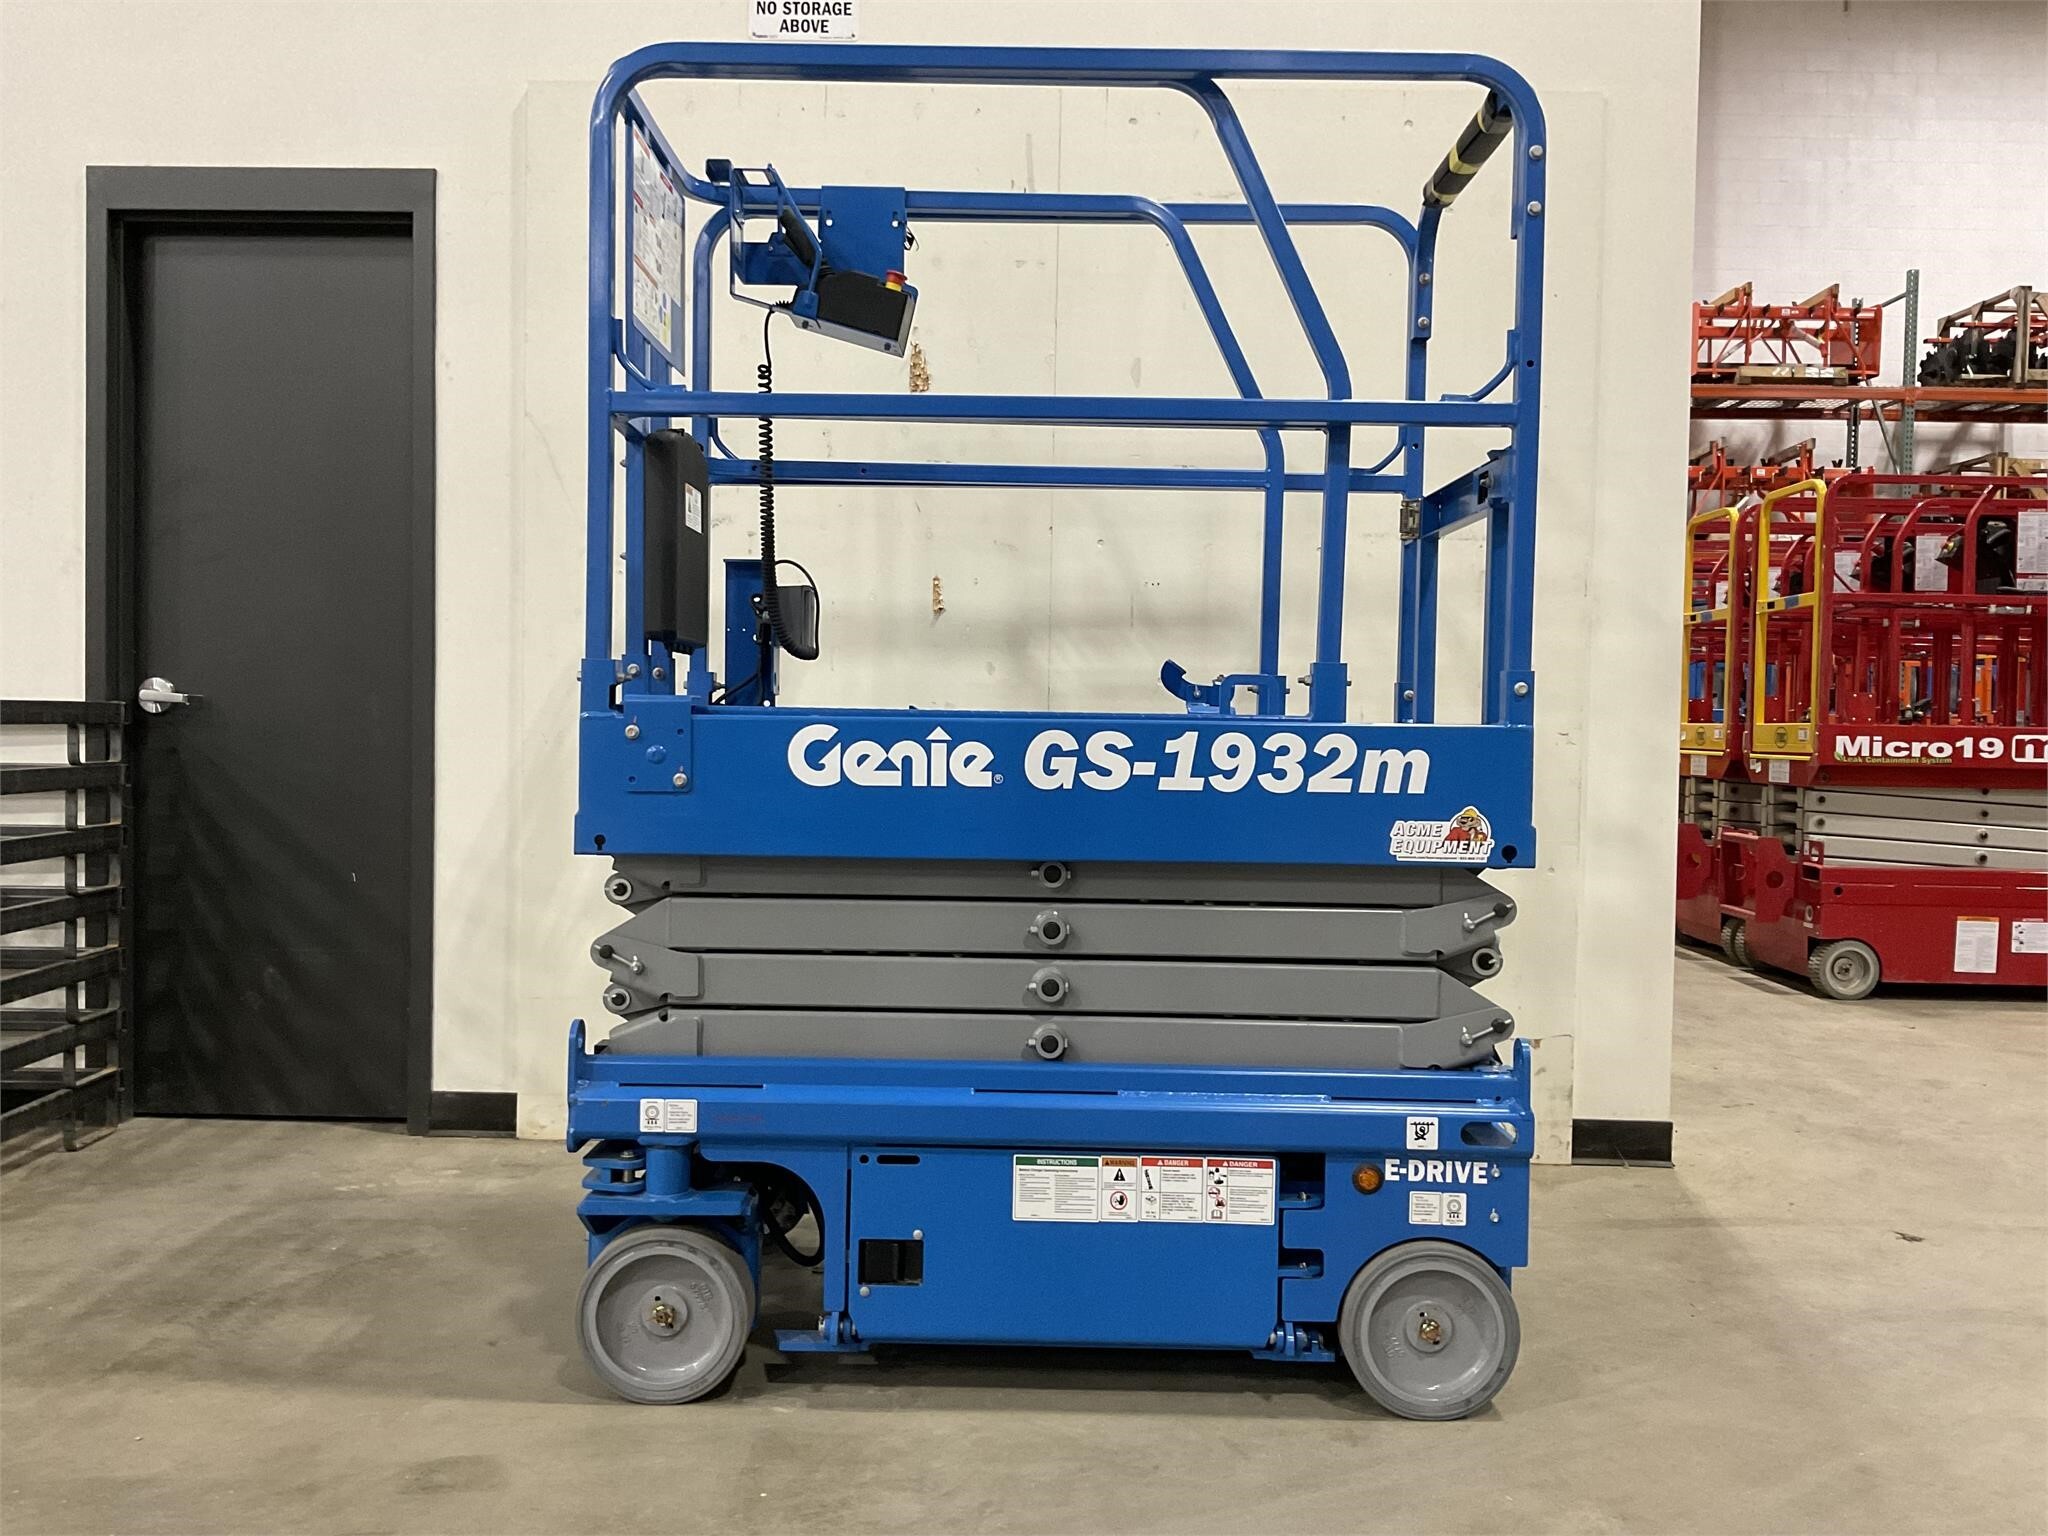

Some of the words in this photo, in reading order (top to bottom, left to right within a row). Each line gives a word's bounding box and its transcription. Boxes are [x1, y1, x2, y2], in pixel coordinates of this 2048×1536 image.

[757, 1, 777, 15] NO
[783, 1, 852, 16] STORAGE
[780, 19, 829, 33] ABOVE
[1835, 735, 2005, 759] Micro19
[787, 724, 995, 787] Genie
[1024, 729, 1431, 794] GS-1932m
[1921, 757, 1953, 765] System
[1393, 823, 1443, 838] ACME
[1392, 839, 1494, 855] EQUIPMENT
[1036, 1158, 1078, 1166] INSTRUCTIONS
[1229, 1160, 1258, 1168] DANGER
[1385, 1158, 1489, 1185] E-DRIVE
